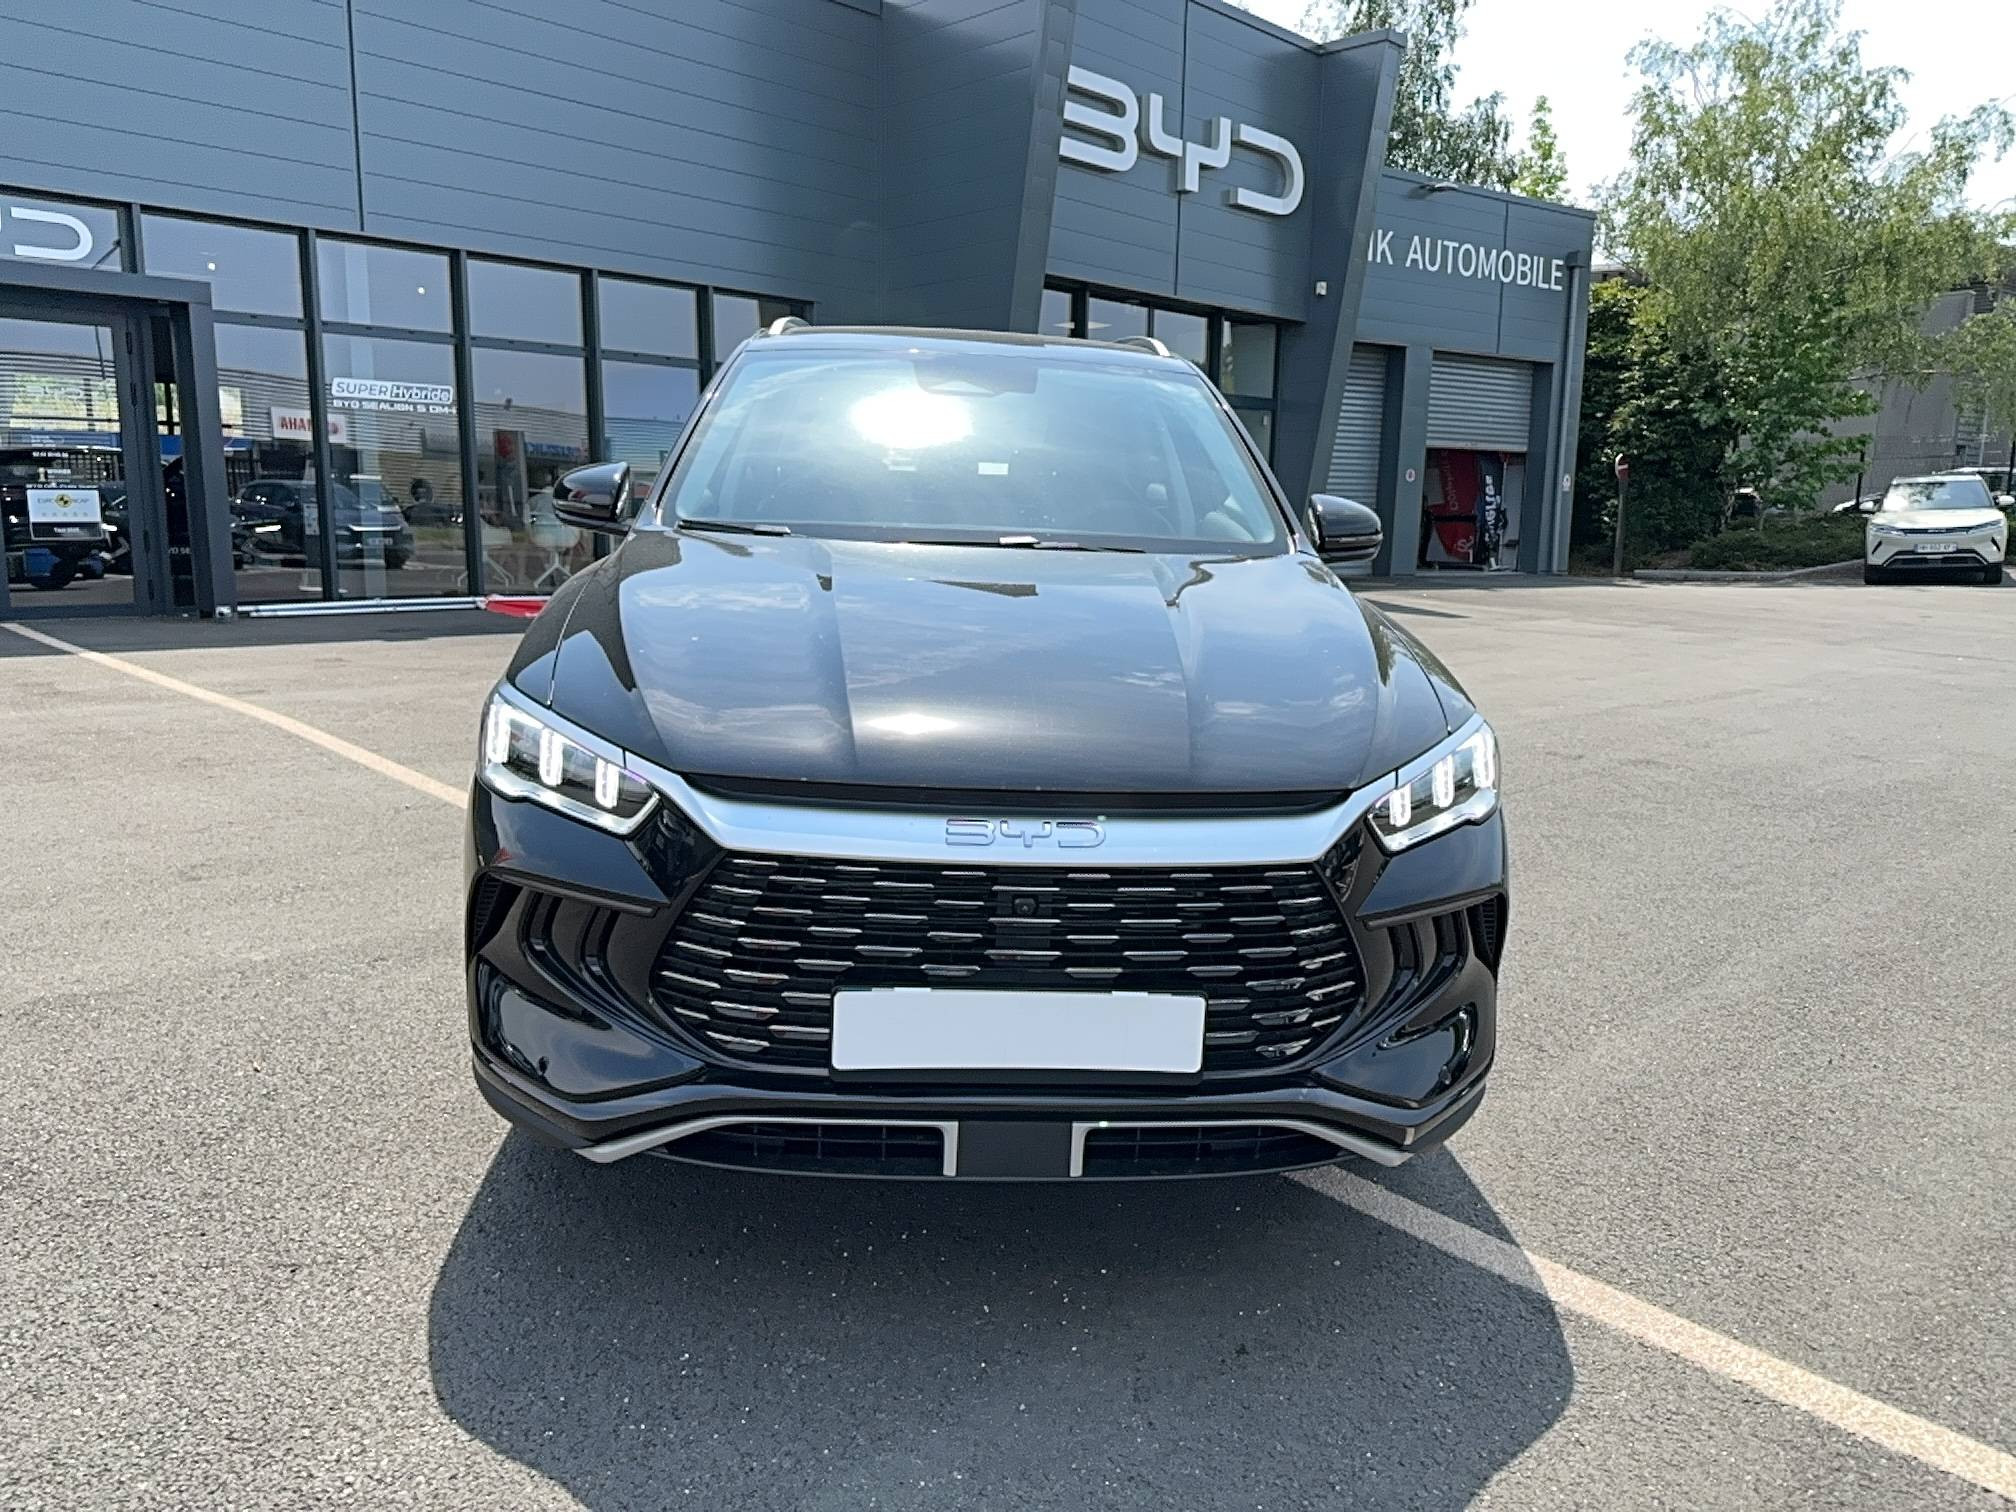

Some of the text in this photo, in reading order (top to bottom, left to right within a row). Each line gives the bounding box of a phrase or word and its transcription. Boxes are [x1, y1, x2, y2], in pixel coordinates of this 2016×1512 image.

[1059, 64, 1304, 216] BYD
[1405, 235, 1564, 291] AUTOMOBILE
[335, 381, 390, 397] SUPER
[945, 818, 1106, 848] BYD
